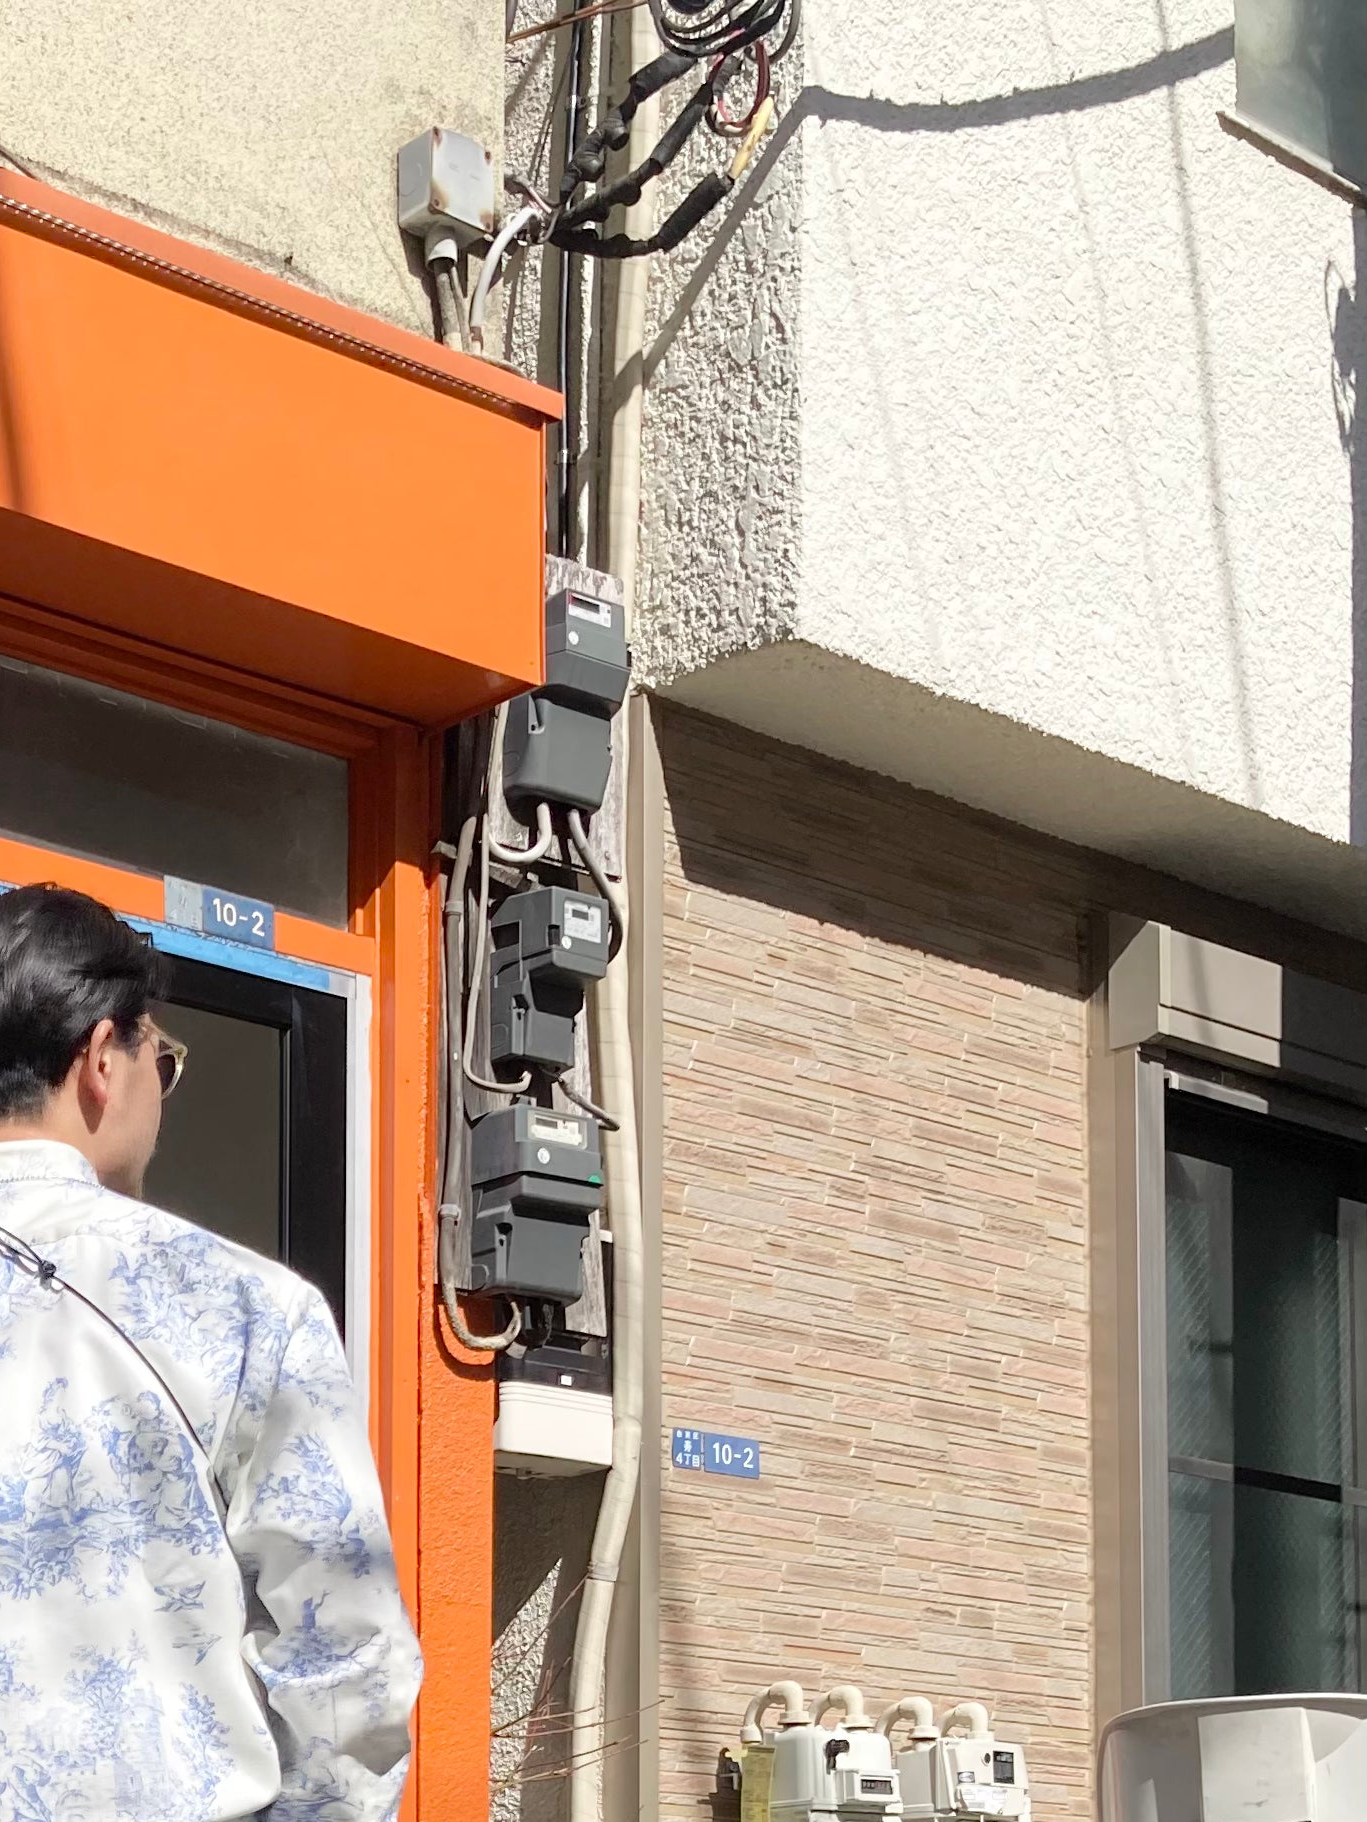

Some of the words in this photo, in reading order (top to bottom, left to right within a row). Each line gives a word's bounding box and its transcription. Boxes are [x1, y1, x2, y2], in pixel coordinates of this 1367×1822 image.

[212, 897, 266, 937] 10-2
[676, 1452, 700, 1467] 4丁目
[712, 1442, 754, 1469] 10-2
